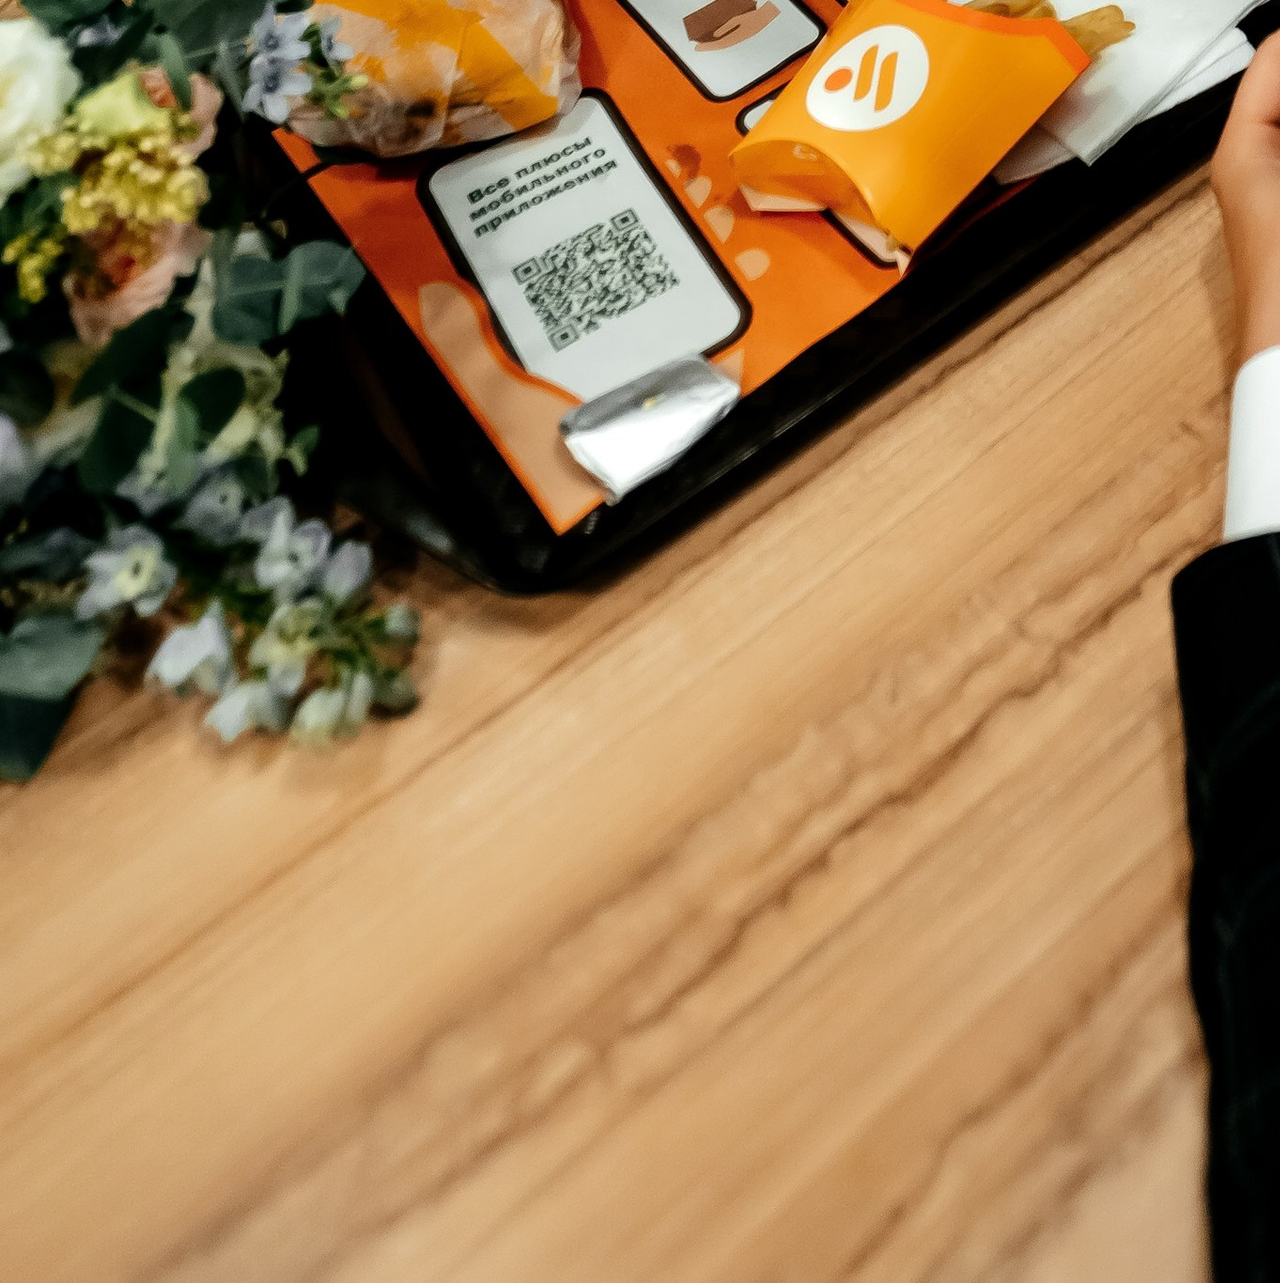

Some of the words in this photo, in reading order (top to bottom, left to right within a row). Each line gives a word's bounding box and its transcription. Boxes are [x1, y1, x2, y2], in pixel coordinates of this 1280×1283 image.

[466, 173, 510, 205] Все
[514, 136, 593, 180] плюсы
[468, 147, 607, 223] мобильного
[473, 159, 619, 239] приложения
